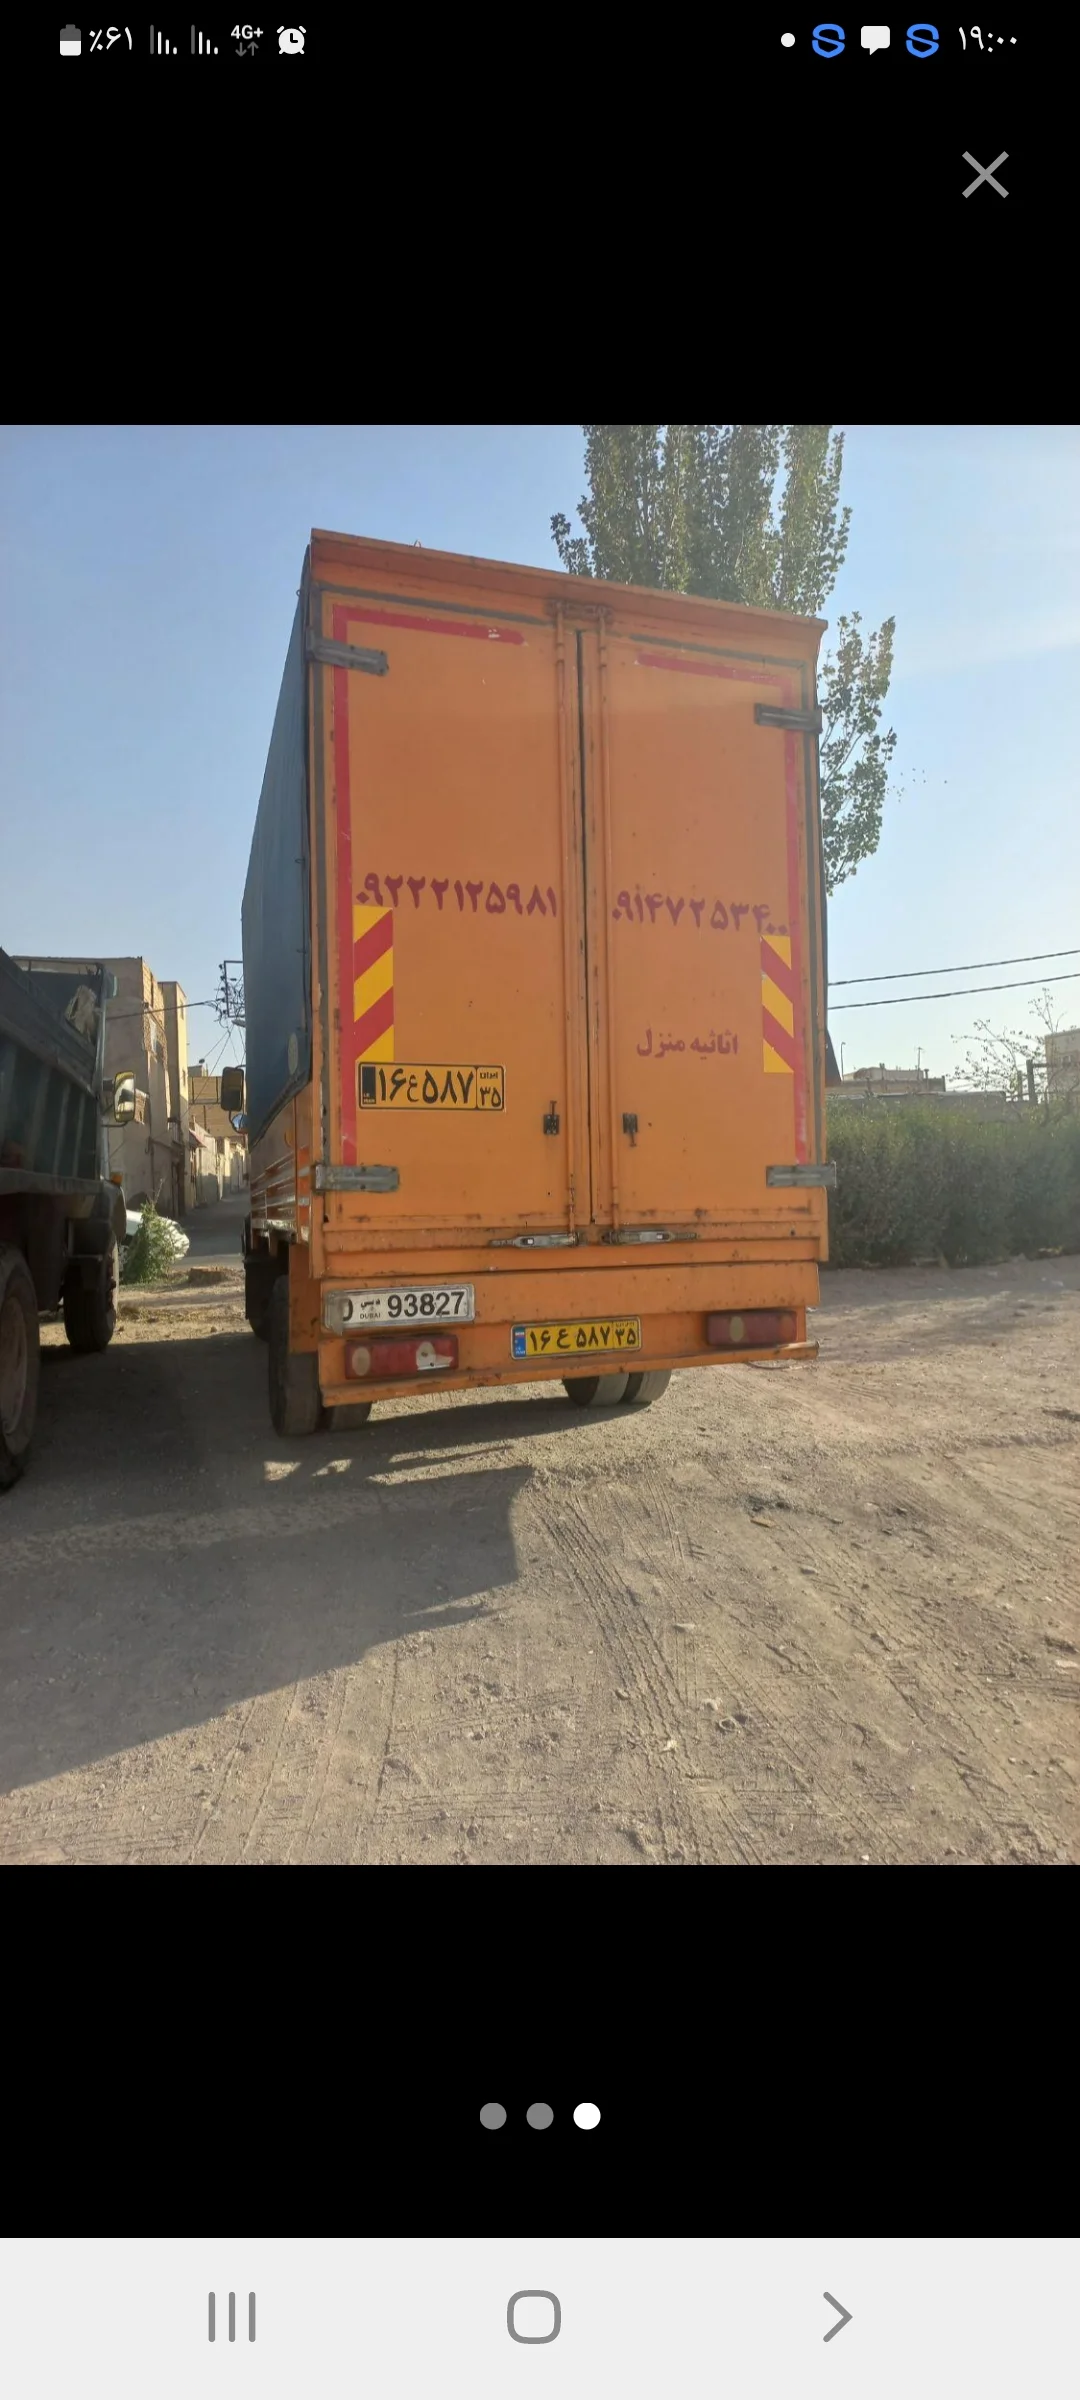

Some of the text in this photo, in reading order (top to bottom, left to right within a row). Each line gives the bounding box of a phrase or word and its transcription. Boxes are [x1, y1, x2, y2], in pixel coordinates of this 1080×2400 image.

[355, 872, 557, 918] ۰۹۲۲۲۱۲۵۹۸۱
[636, 1028, 686, 1058] منزل
[479, 1086, 502, 1107] ۳۵
[386, 1290, 466, 1319] 93827
